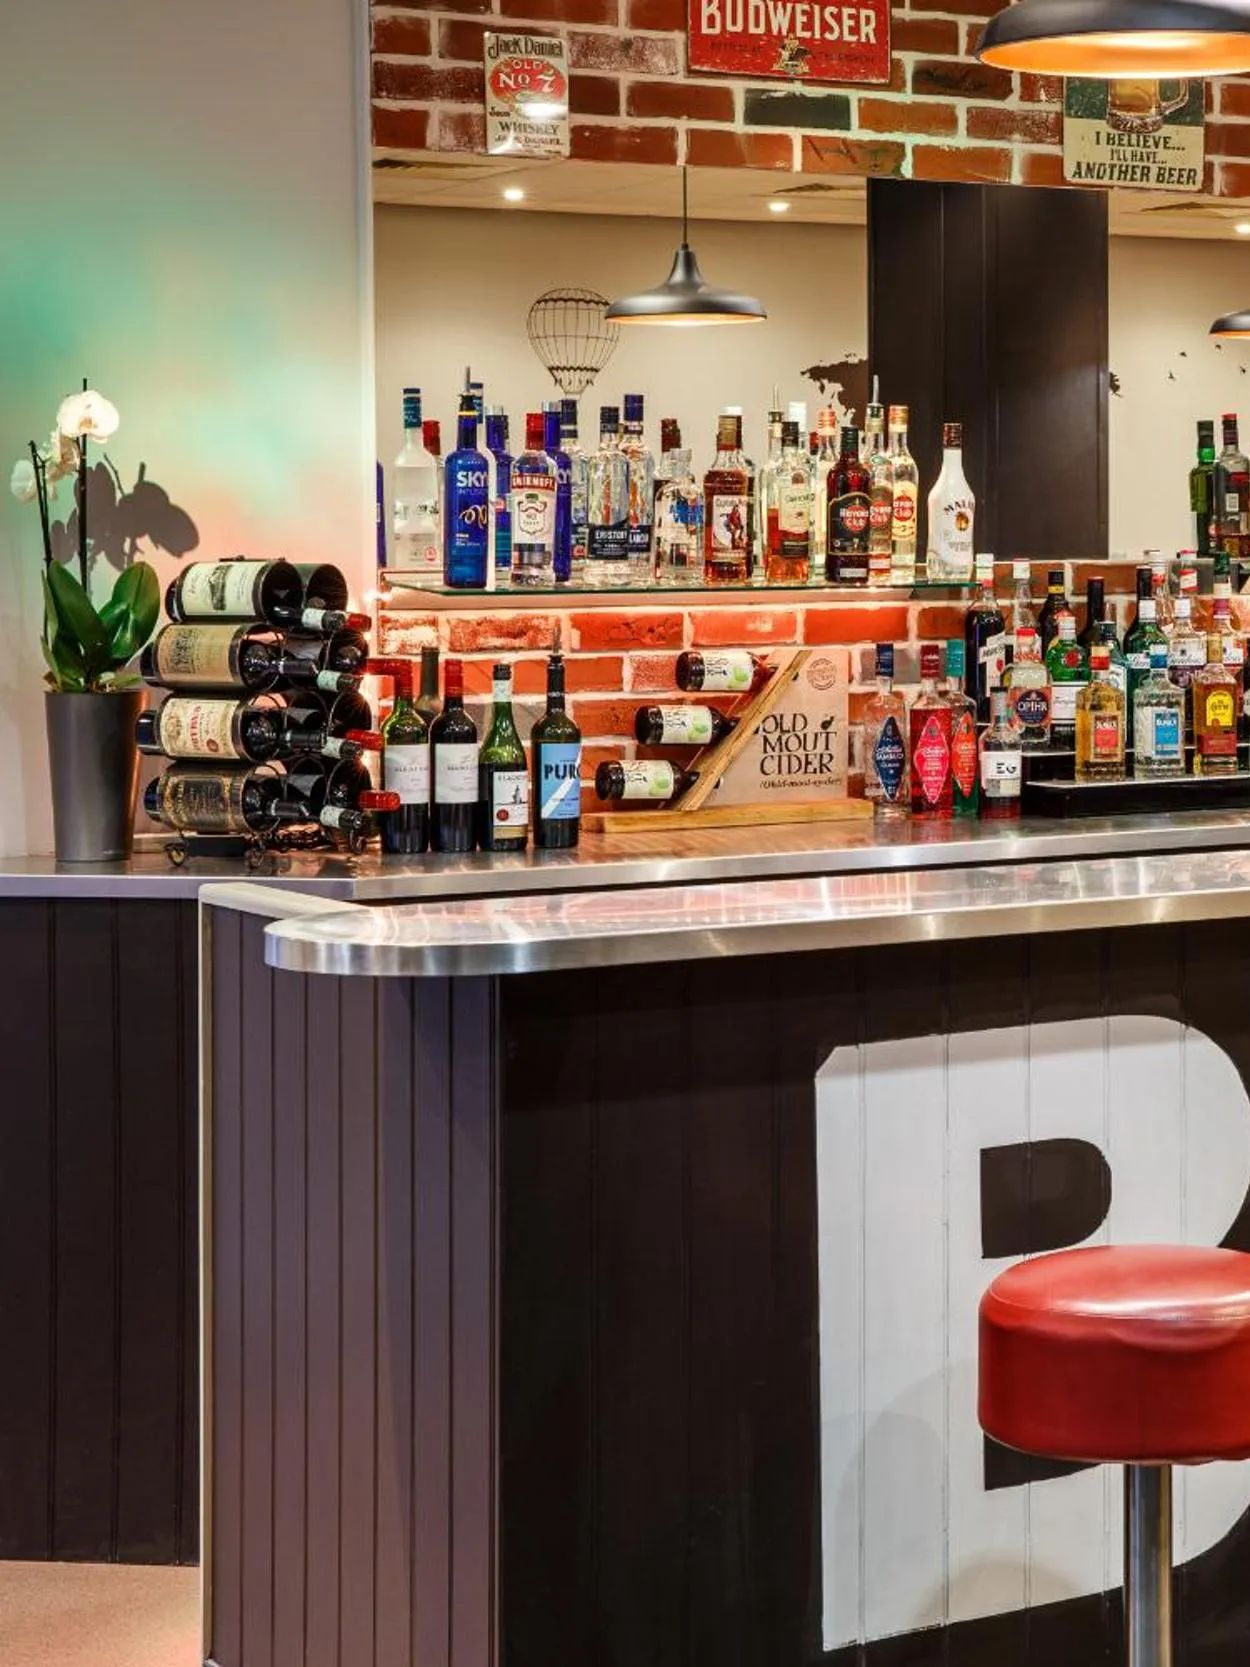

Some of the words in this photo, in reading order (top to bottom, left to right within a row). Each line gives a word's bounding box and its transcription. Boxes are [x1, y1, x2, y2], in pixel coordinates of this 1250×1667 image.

[701, 0, 876, 44] BUDWEISER
[512, 59, 543, 69] OLD
[499, 121, 560, 134] WHISKEY
[1095, 131, 1102, 145] I
[1072, 161, 1150, 183] ANOTHER
[1156, 166, 1198, 186] BEER
[762, 713, 808, 734] OLD
[762, 731, 837, 754] MOUT
[760, 752, 834, 775] CIDER
